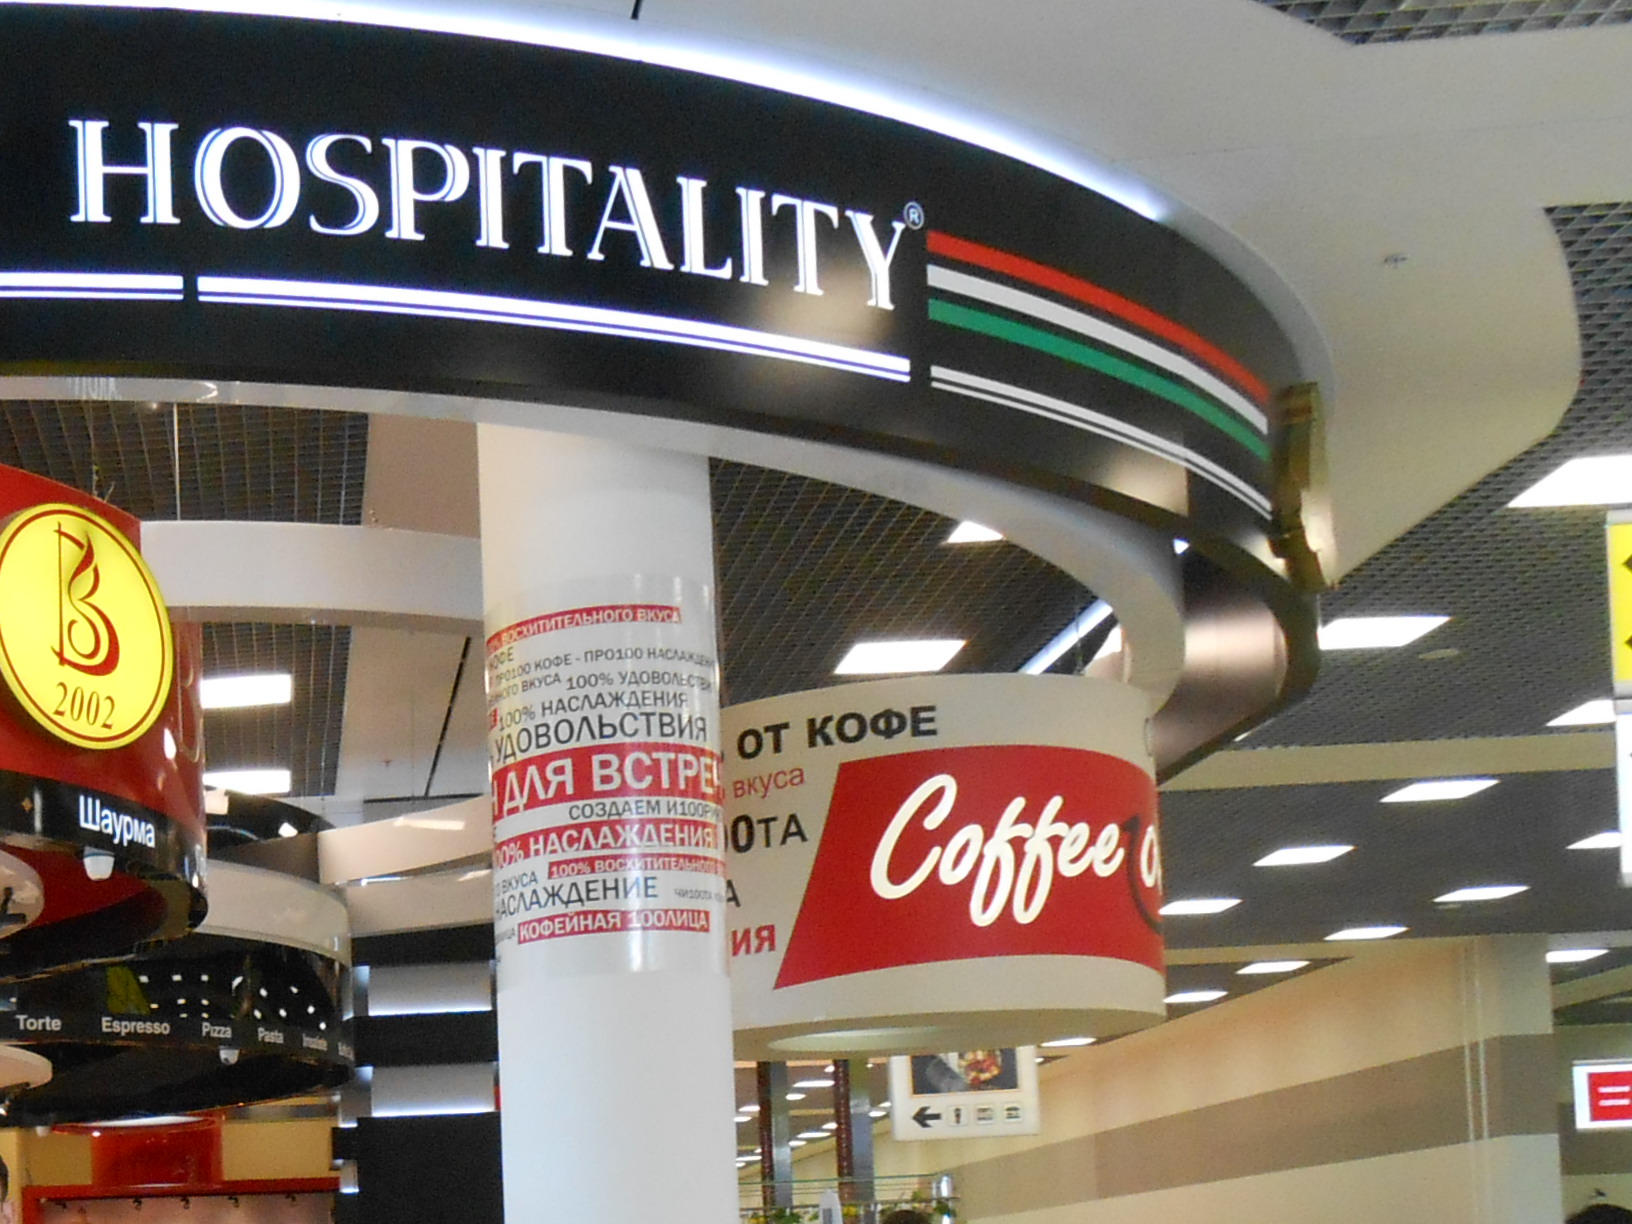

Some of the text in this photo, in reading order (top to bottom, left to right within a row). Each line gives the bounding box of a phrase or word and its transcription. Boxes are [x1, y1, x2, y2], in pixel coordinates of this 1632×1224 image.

[68, 118, 907, 311] HOSPITALITY
[636, 609, 682, 623] ВКУСА
[534, 653, 572, 672] КОФЕ
[522, 672, 562, 693] ВКУСА
[566, 673, 614, 691] 100%
[52, 680, 116, 731] 2002
[541, 690, 688, 718] НАСЛАЖДЕНИЯ
[495, 711, 707, 764] УДОВОЛЬСТВИЯ
[737, 705, 938, 760] ОТ КОФЕ
[502, 757, 575, 817] ДЛЯ
[733, 767, 805, 799] вкуса
[79, 794, 156, 849] Шаурма
[568, 799, 661, 820] СОЗДАЕМ
[530, 823, 713, 858] НАСЛАЖДЕНИЯ
[870, 773, 1125, 927] Coffee
[550, 860, 591, 879] 100%
[519, 911, 622, 943] КОФЕЙНАЯ
[15, 1013, 63, 1032] Torte
[101, 1016, 171, 1036] Espresso
[201, 1021, 232, 1039] Pizza
[257, 1026, 284, 1044] Pasta
